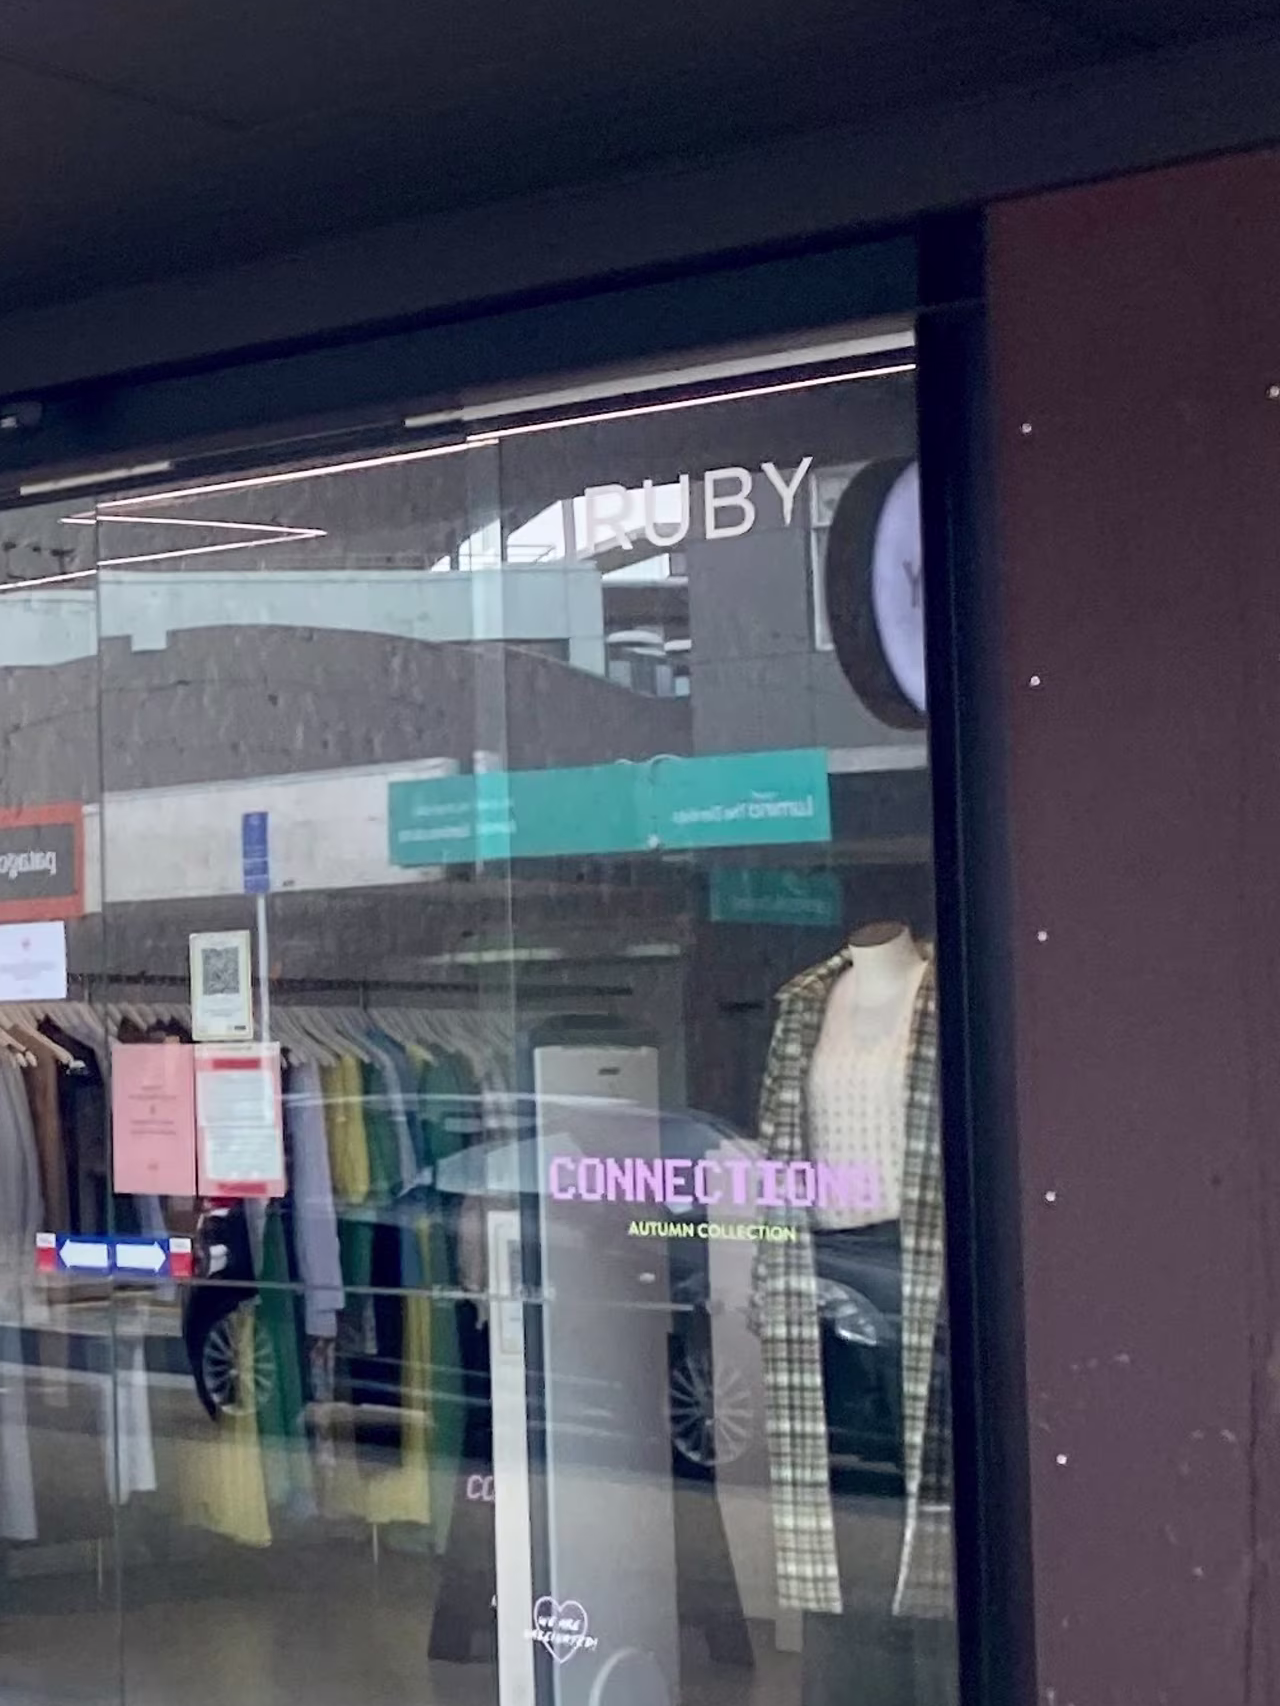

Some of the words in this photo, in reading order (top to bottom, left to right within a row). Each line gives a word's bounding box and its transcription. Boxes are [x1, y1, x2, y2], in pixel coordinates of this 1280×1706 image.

[583, 456, 814, 554] RUBY
[548, 1156, 881, 1210] CONNECTIONS
[628, 1220, 694, 1238] AUTUMN
[697, 1223, 796, 1242] COLLECTION
